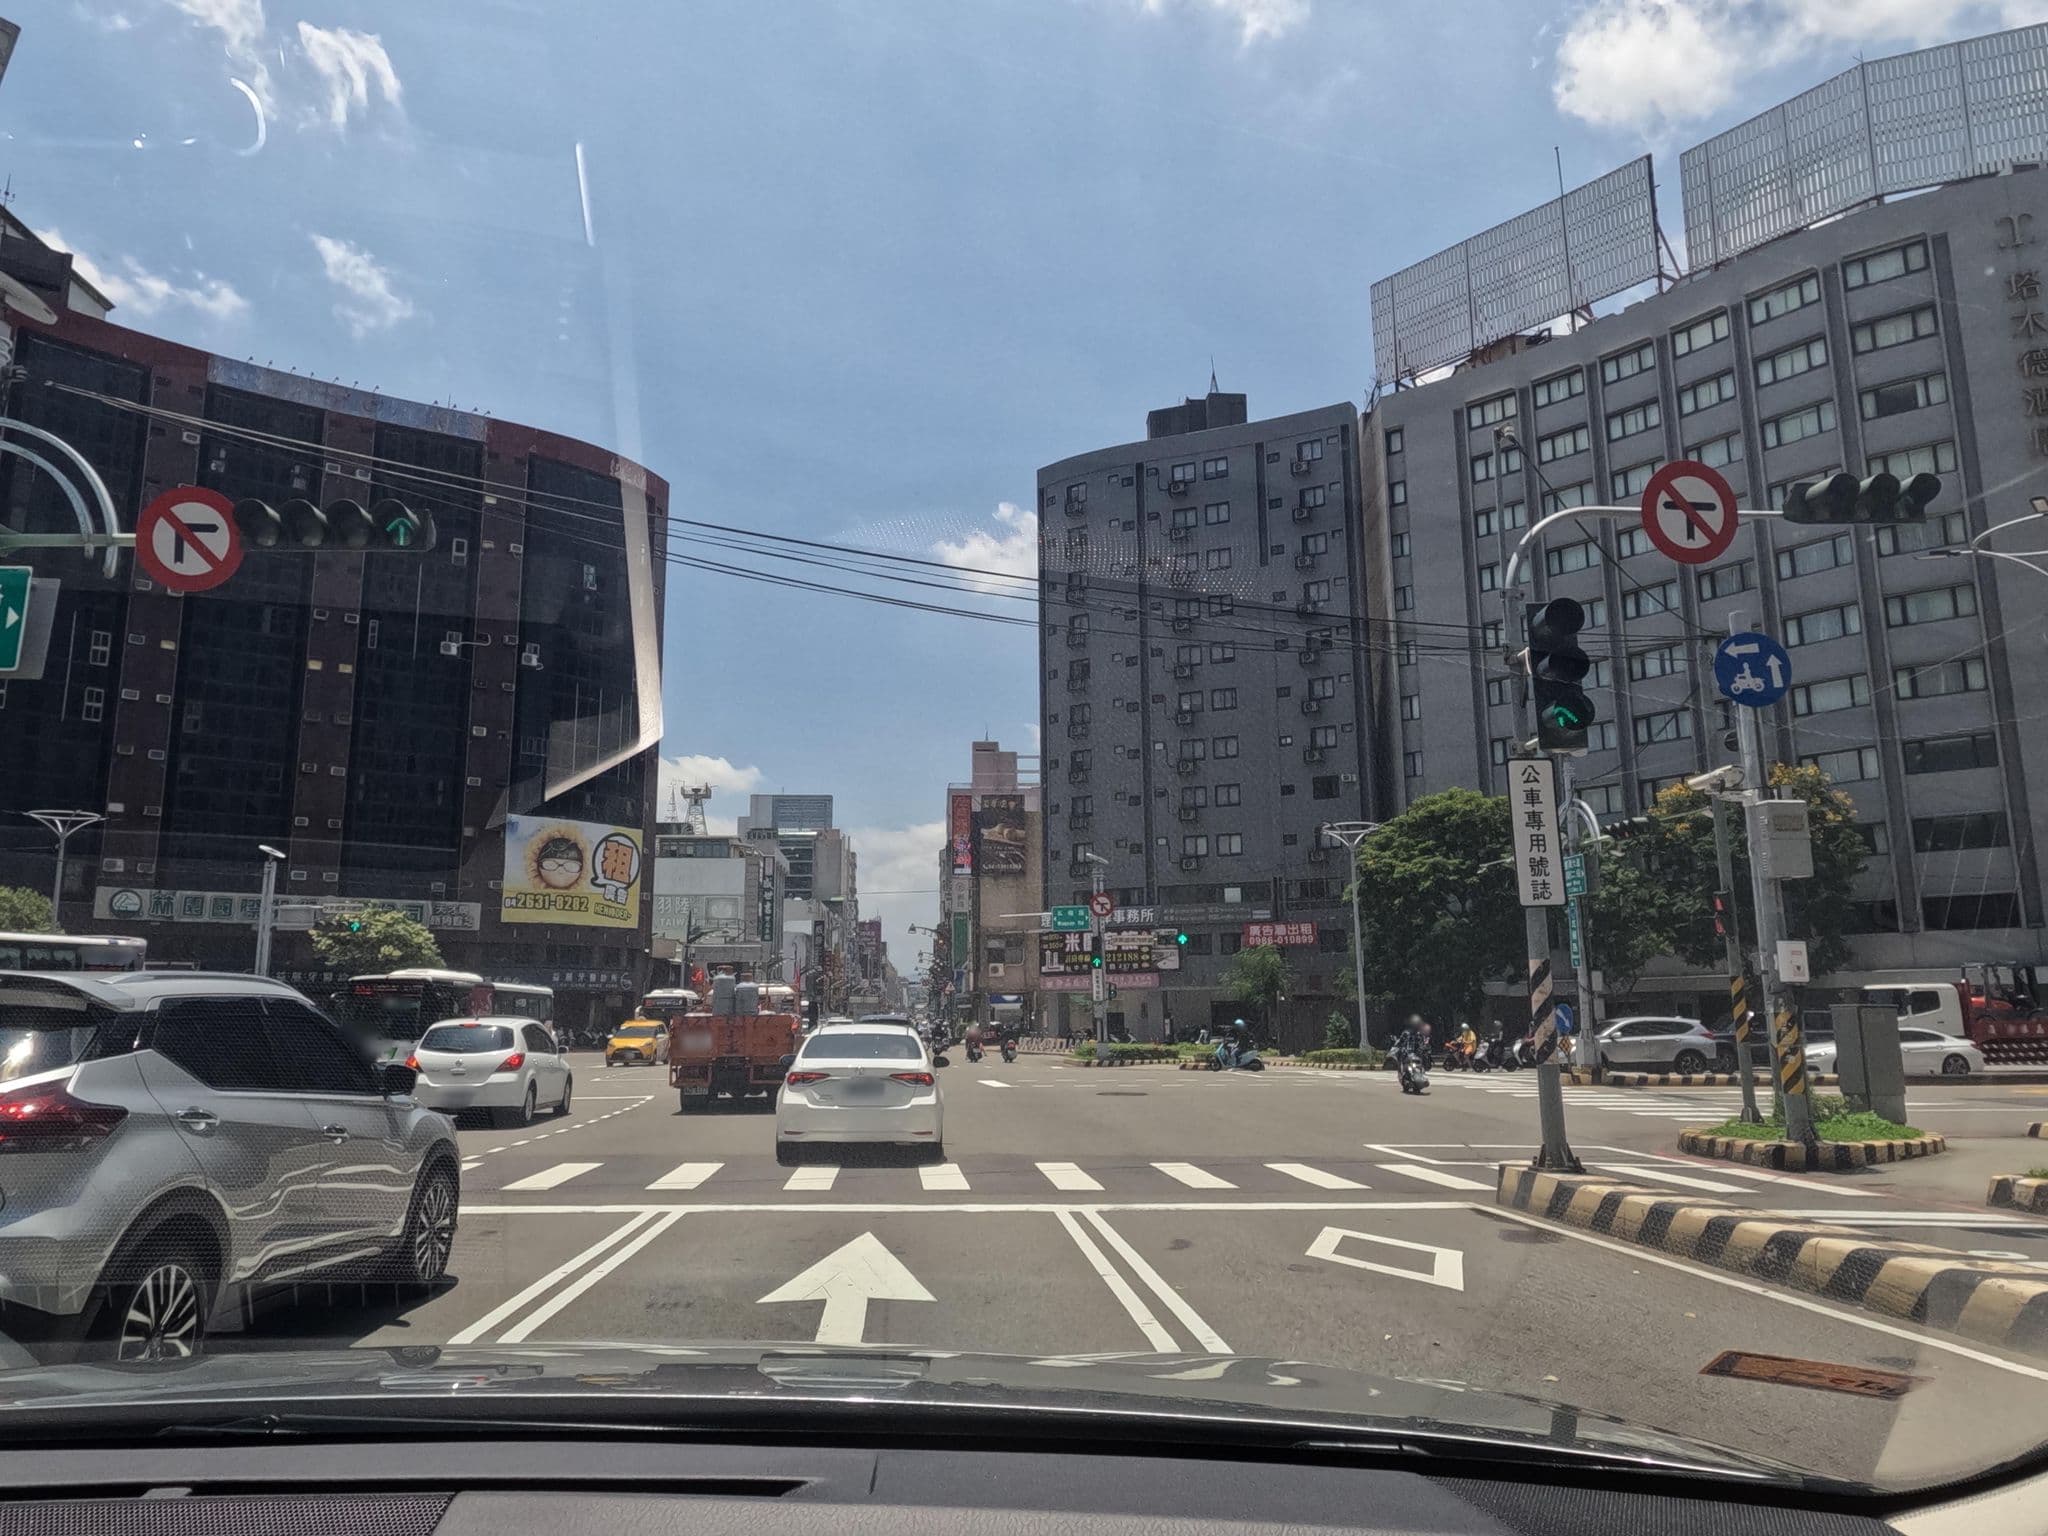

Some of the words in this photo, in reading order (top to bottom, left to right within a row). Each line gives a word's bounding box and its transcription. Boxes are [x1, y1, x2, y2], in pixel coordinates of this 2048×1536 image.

[602, 840, 633, 884] 租
[1520, 764, 1552, 901] 公車專用號誌
